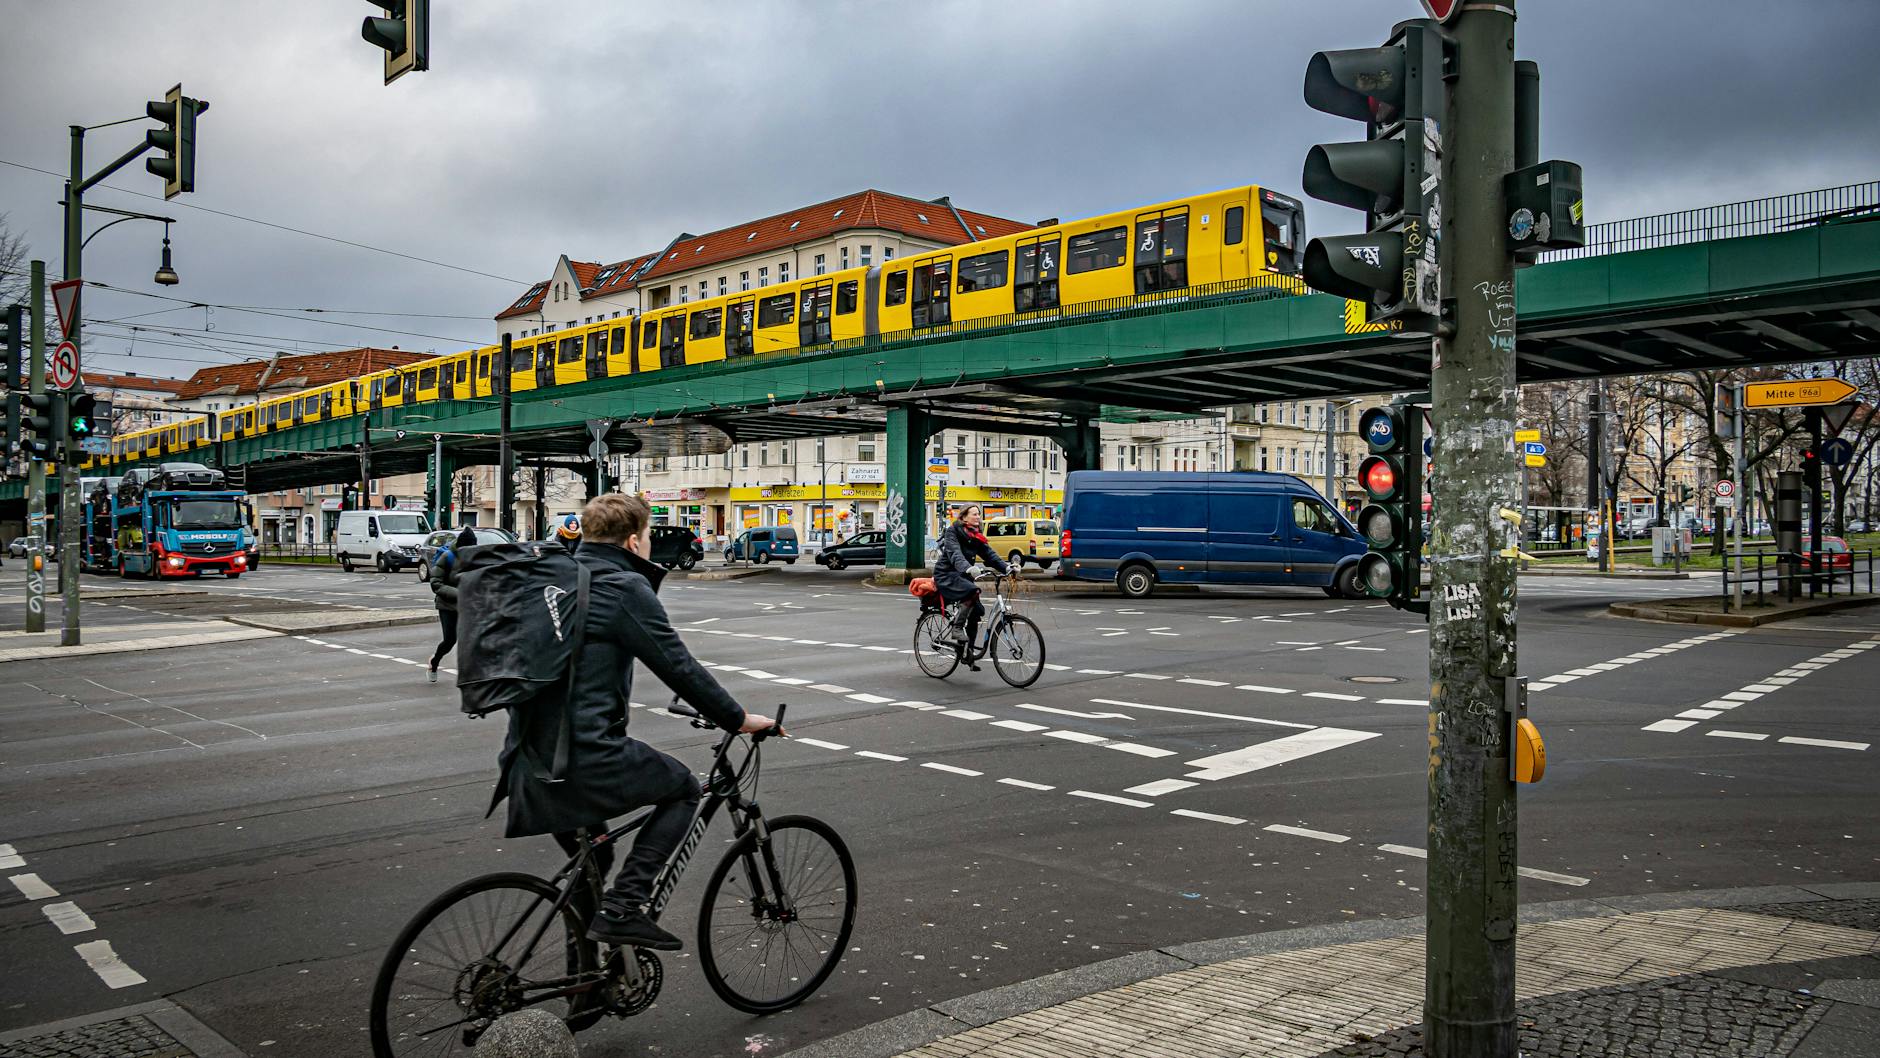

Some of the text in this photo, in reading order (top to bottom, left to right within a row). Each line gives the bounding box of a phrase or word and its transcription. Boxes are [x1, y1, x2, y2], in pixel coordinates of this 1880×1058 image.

[1390, 320, 1404, 330] K7
[1766, 388, 1819, 399] Mitte 96a
[773, 489, 805, 498] Matratzen
[855, 489, 886, 497] Matratze
[1719, 485, 1730, 493] 30
[1003, 490, 1039, 500] Matratzen
[1443, 582, 1480, 602] LISA
[655, 816, 707, 912] SPECIALIZED
